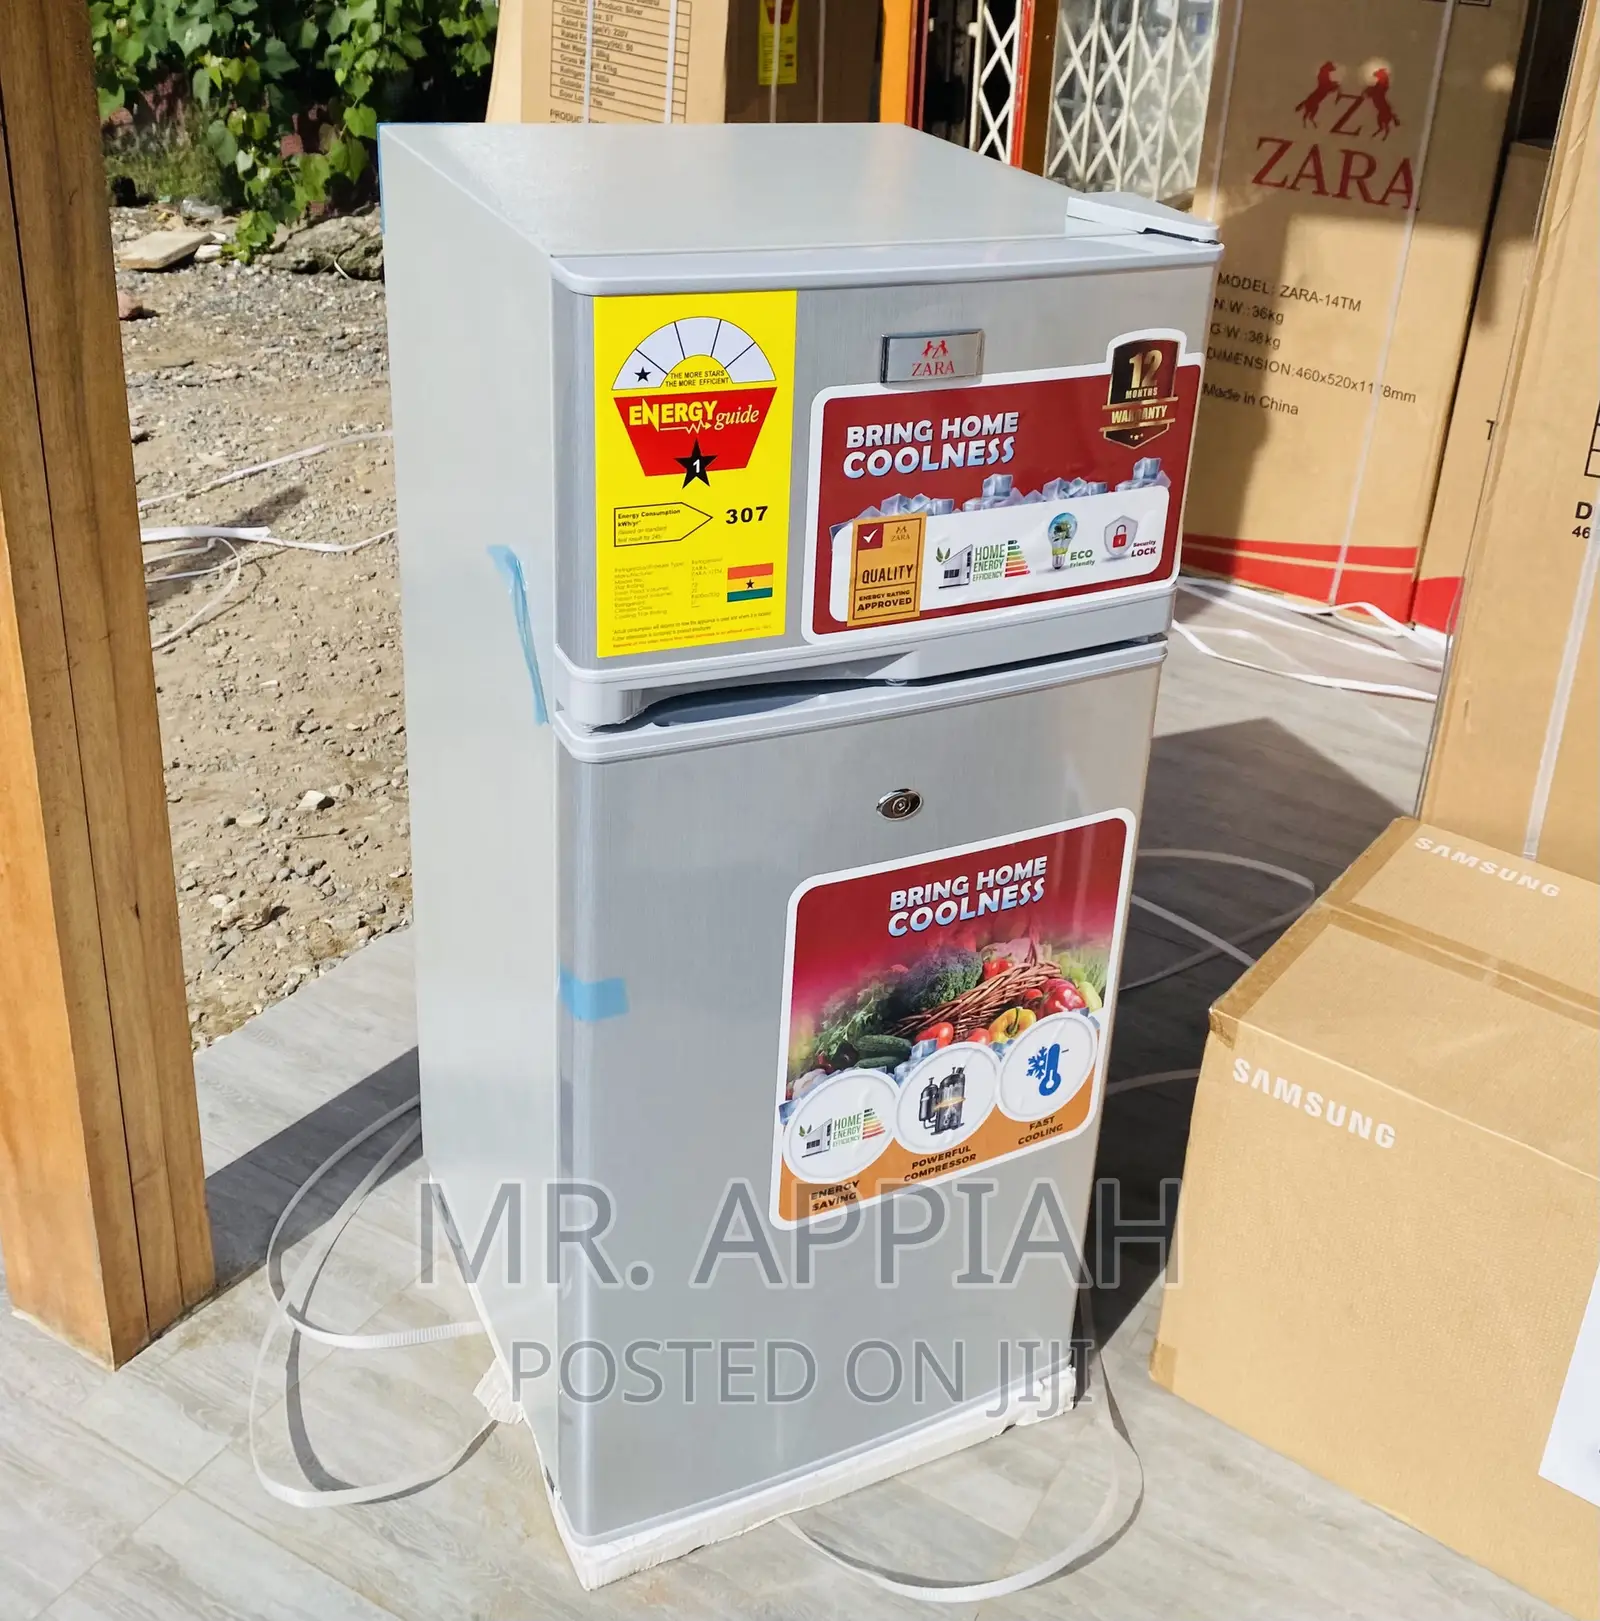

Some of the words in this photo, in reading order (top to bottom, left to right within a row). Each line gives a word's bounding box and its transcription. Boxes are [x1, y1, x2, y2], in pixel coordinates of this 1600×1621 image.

[1251, 136, 1420, 211] ZARA
[1217, 272, 1275, 295] MODEL:
[1280, 284, 1362, 312] ZARA-14TM
[704, 369, 725, 377] STARS
[912, 360, 956, 377] ZARA
[1128, 349, 1163, 389] 12
[1206, 346, 1417, 404] DIMENSION:460x520x118mm
[665, 380, 678, 388] THE
[678, 379, 696, 387] MORE
[699, 377, 729, 386] EFFICIENT
[1125, 386, 1158, 399] MONTHS
[1203, 383, 1241, 402] Made
[1243, 390, 1256, 405] in
[1260, 395, 1299, 416] China
[628, 398, 718, 432] ENERGY
[714, 404, 760, 431] guide
[845, 419, 934, 449] BRING
[941, 411, 1019, 440] HOME
[692, 459, 700, 474] 1
[843, 436, 1016, 480] COOLNESS
[617, 512, 639, 520] Energy
[641, 508, 681, 518] Consumption
[725, 505, 769, 525] 307
[974, 543, 1006, 562] HOME
[1130, 546, 1157, 558] LOCK
[1133, 539, 1157, 548] Security
[1069, 549, 1093, 561] ECO
[1069, 559, 1096, 569] Friendly
[861, 564, 914, 585] QUALITY
[973, 559, 1004, 573] ENERGY
[972, 571, 1003, 582] EFFICIENCY
[856, 597, 912, 613] APPROVED
[858, 592, 886, 602] ENERGY
[886, 589, 910, 598] RATING
[1414, 836, 1561, 898] SAMSUNG
[888, 875, 970, 913] BRING
[976, 855, 1048, 889] HOME
[886, 876, 1047, 938] COOLNESS
[1232, 1056, 1397, 1150] SAMSUNG
[833, 1112, 863, 1131] HOME
[1029, 1115, 1055, 1131] FAST
[832, 1125, 861, 1140] ENERGY
[1018, 1123, 1064, 1145] COOLING
[903, 1153, 977, 1182] COMPRESSOR
[911, 1145, 971, 1170] POWERFUL
[810, 1179, 860, 1200] ENERGY
[811, 1191, 857, 1212] SAVING
